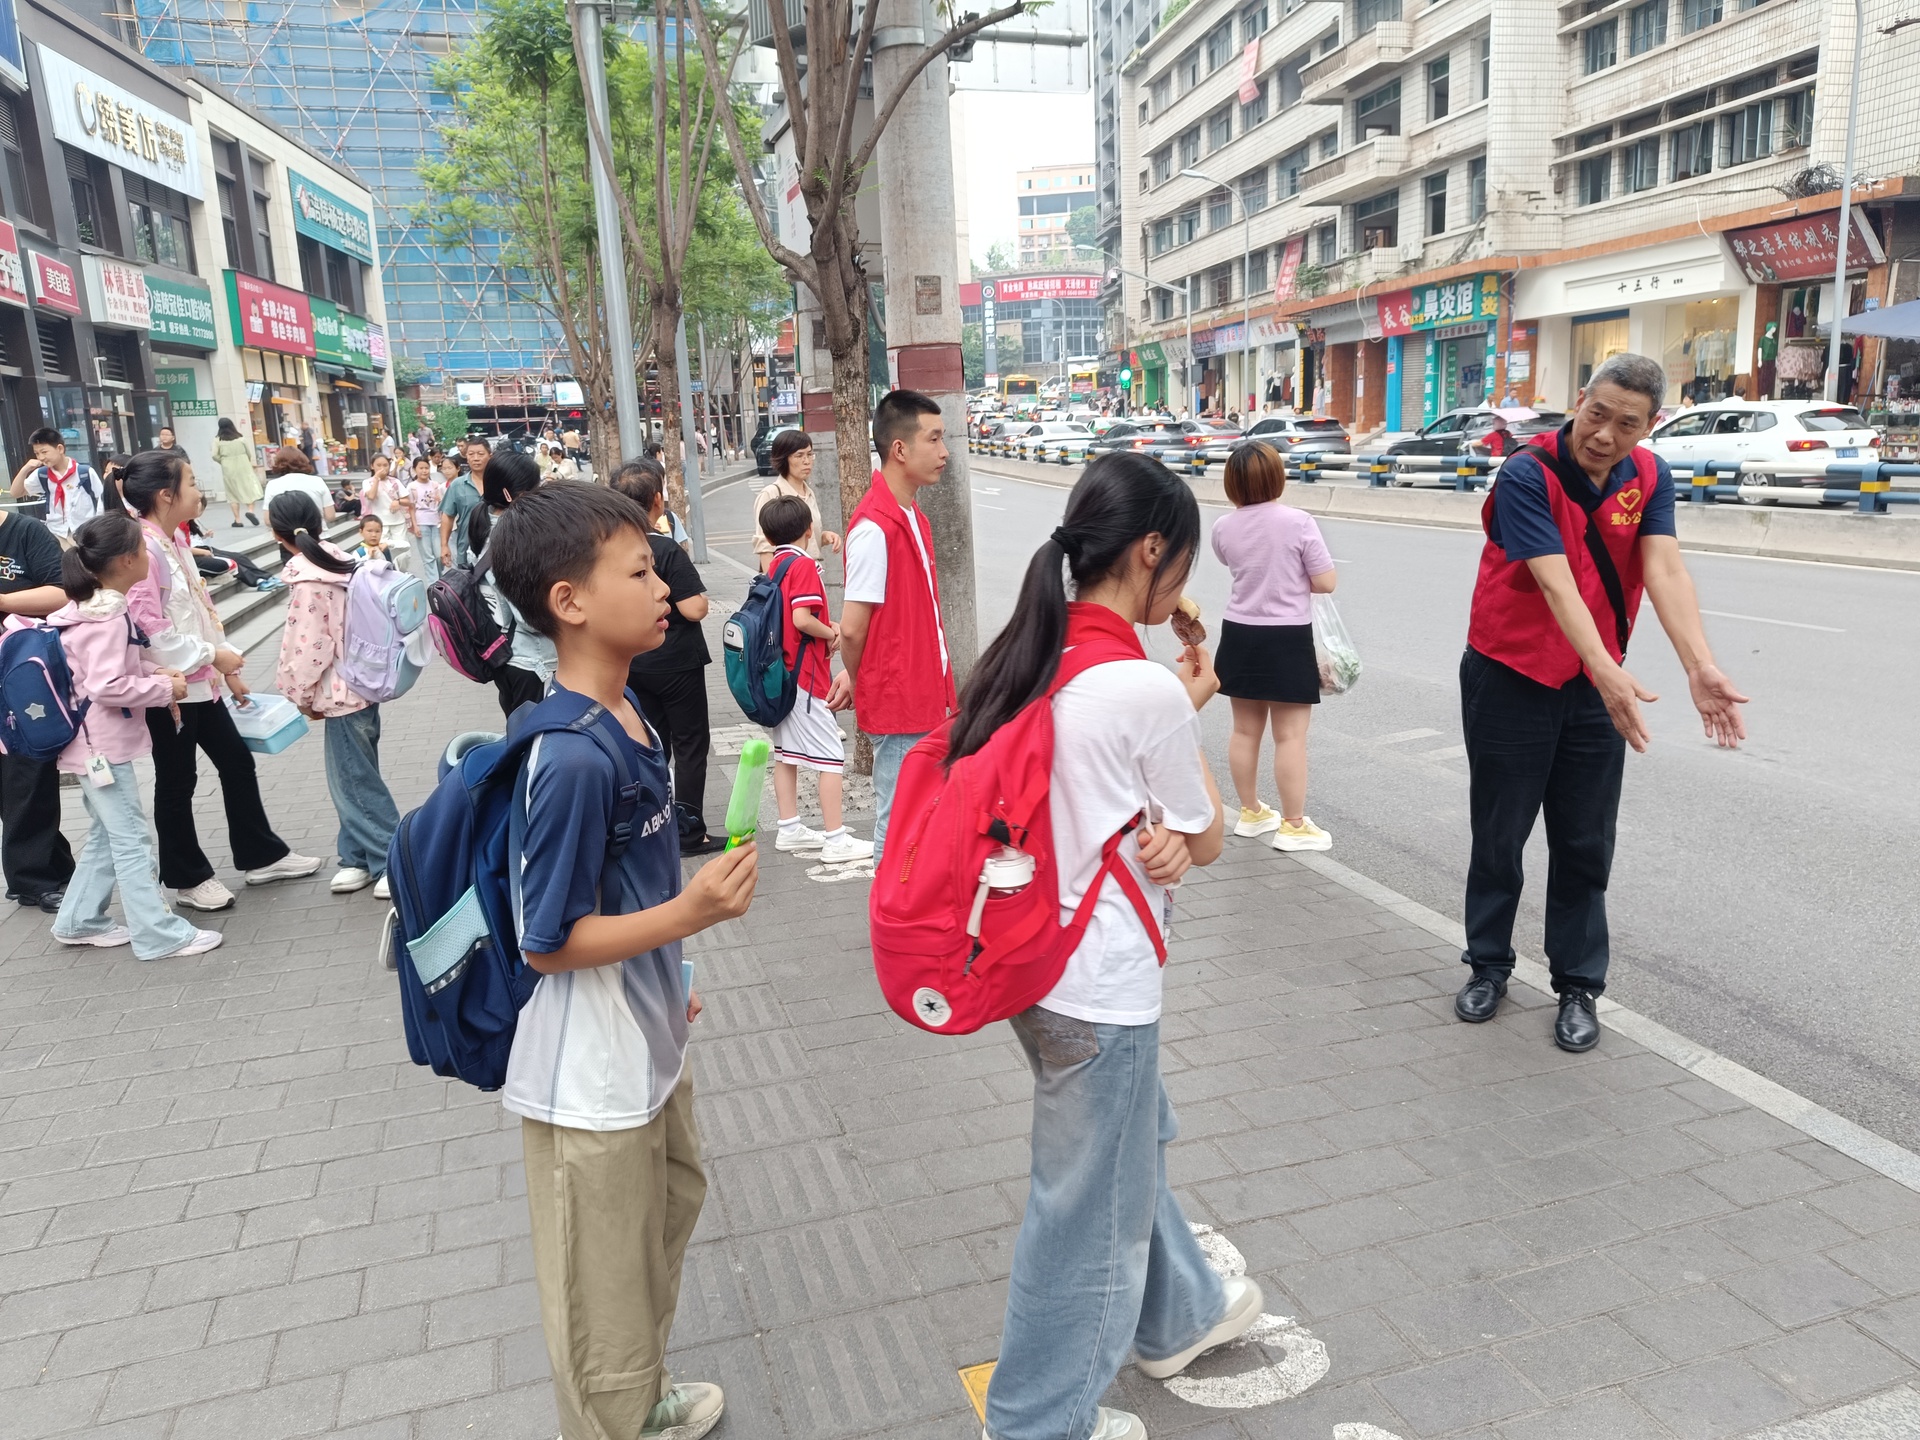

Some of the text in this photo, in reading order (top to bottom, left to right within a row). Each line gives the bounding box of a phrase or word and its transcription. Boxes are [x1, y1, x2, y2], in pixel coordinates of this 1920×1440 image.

[45, 266, 72, 297] 美宜佳
[102, 262, 146, 300] 林铺盖面
[1065, 279, 1086, 289] 交通便利
[1617, 275, 1660, 293] 十三行
[1423, 281, 1474, 322] 鼻炎馆
